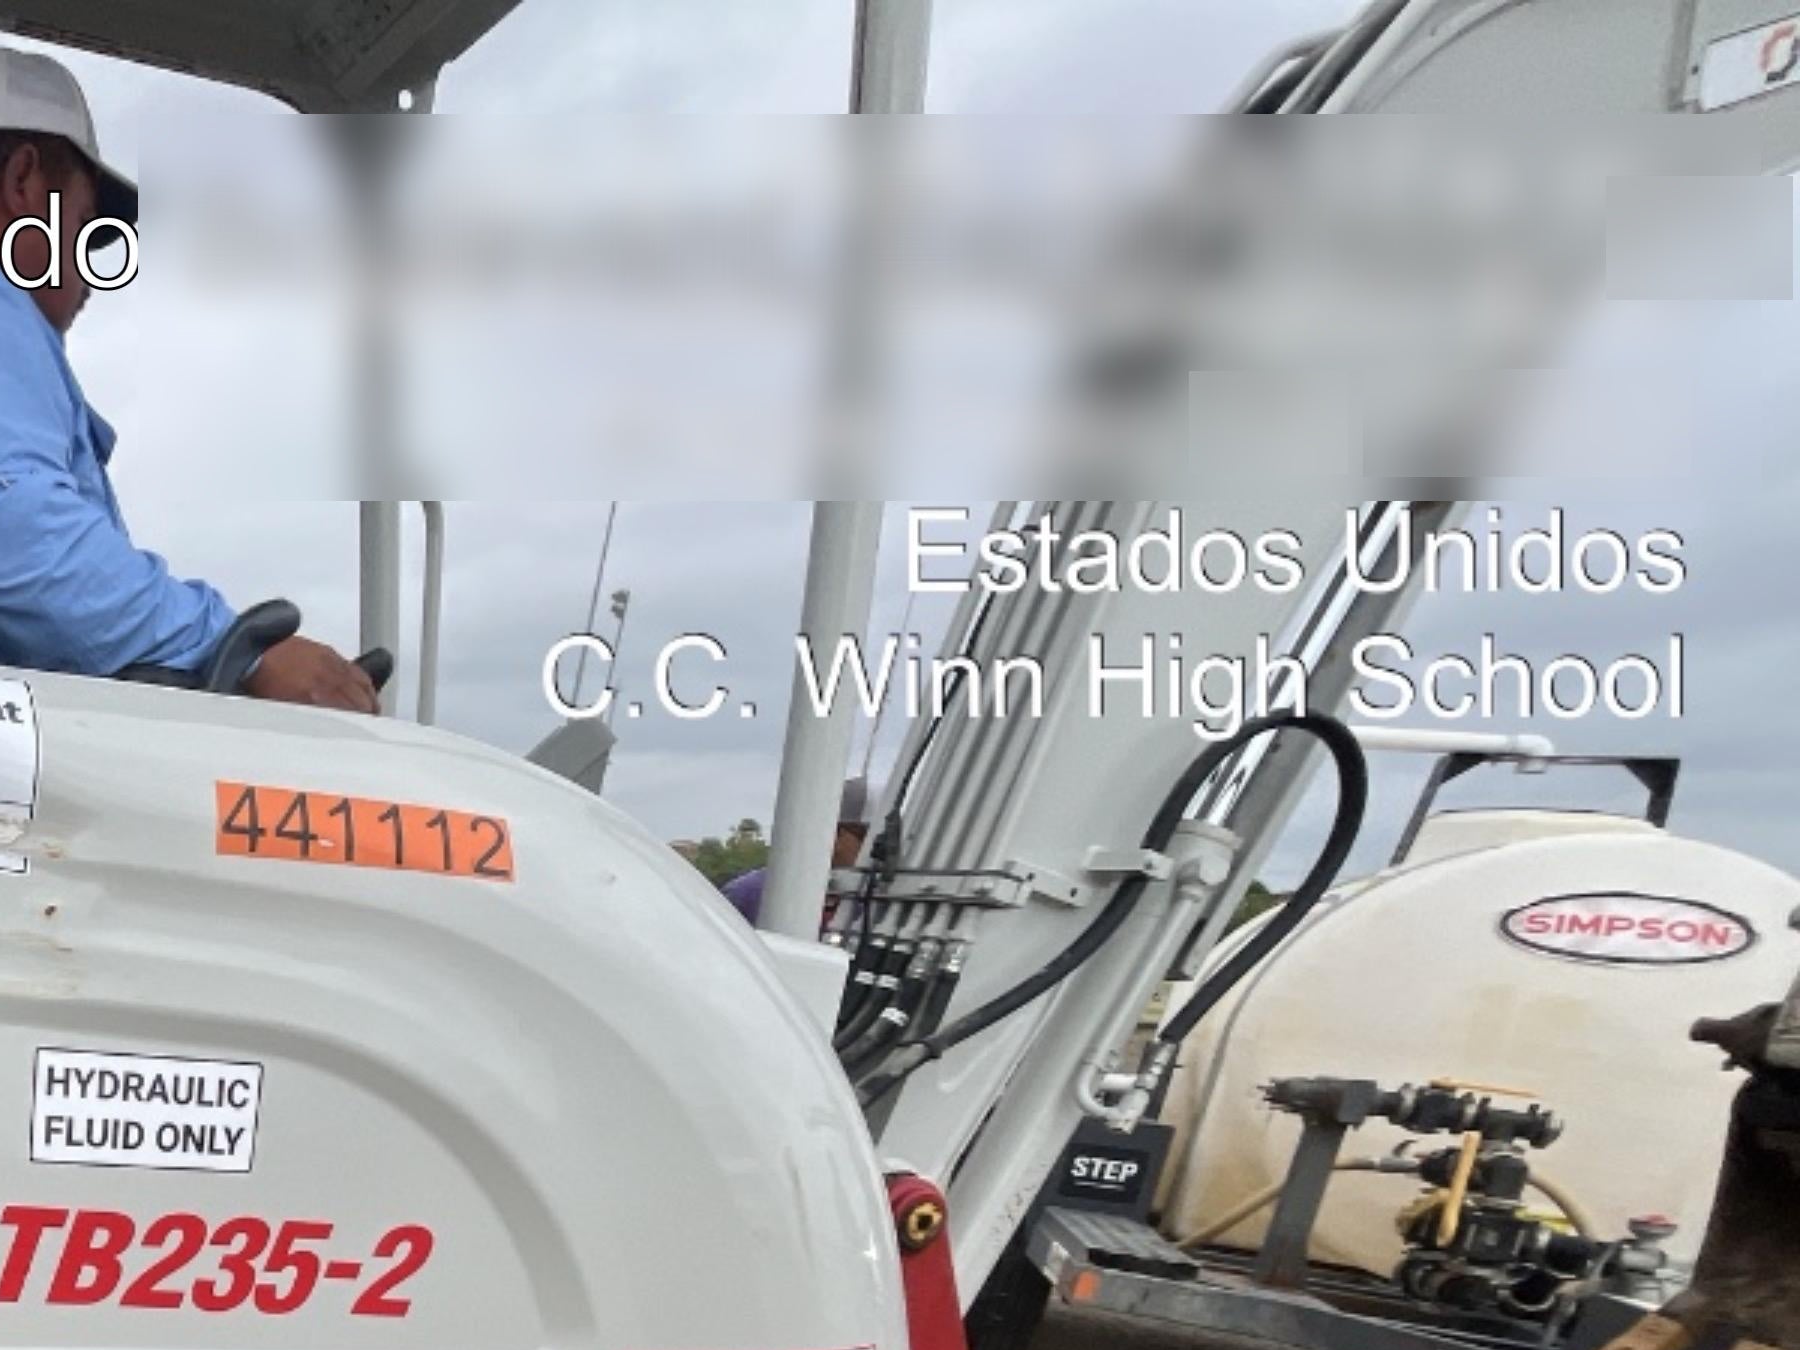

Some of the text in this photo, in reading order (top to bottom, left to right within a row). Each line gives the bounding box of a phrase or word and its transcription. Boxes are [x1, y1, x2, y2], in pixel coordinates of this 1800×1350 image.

[221, 785, 511, 877] 441112
[1523, 912, 1730, 946] SIMPSON
[45, 1065, 251, 1109] HYDRAULIC
[43, 1115, 246, 1156] FLUID ONLY
[1070, 1154, 1139, 1183] STEP
